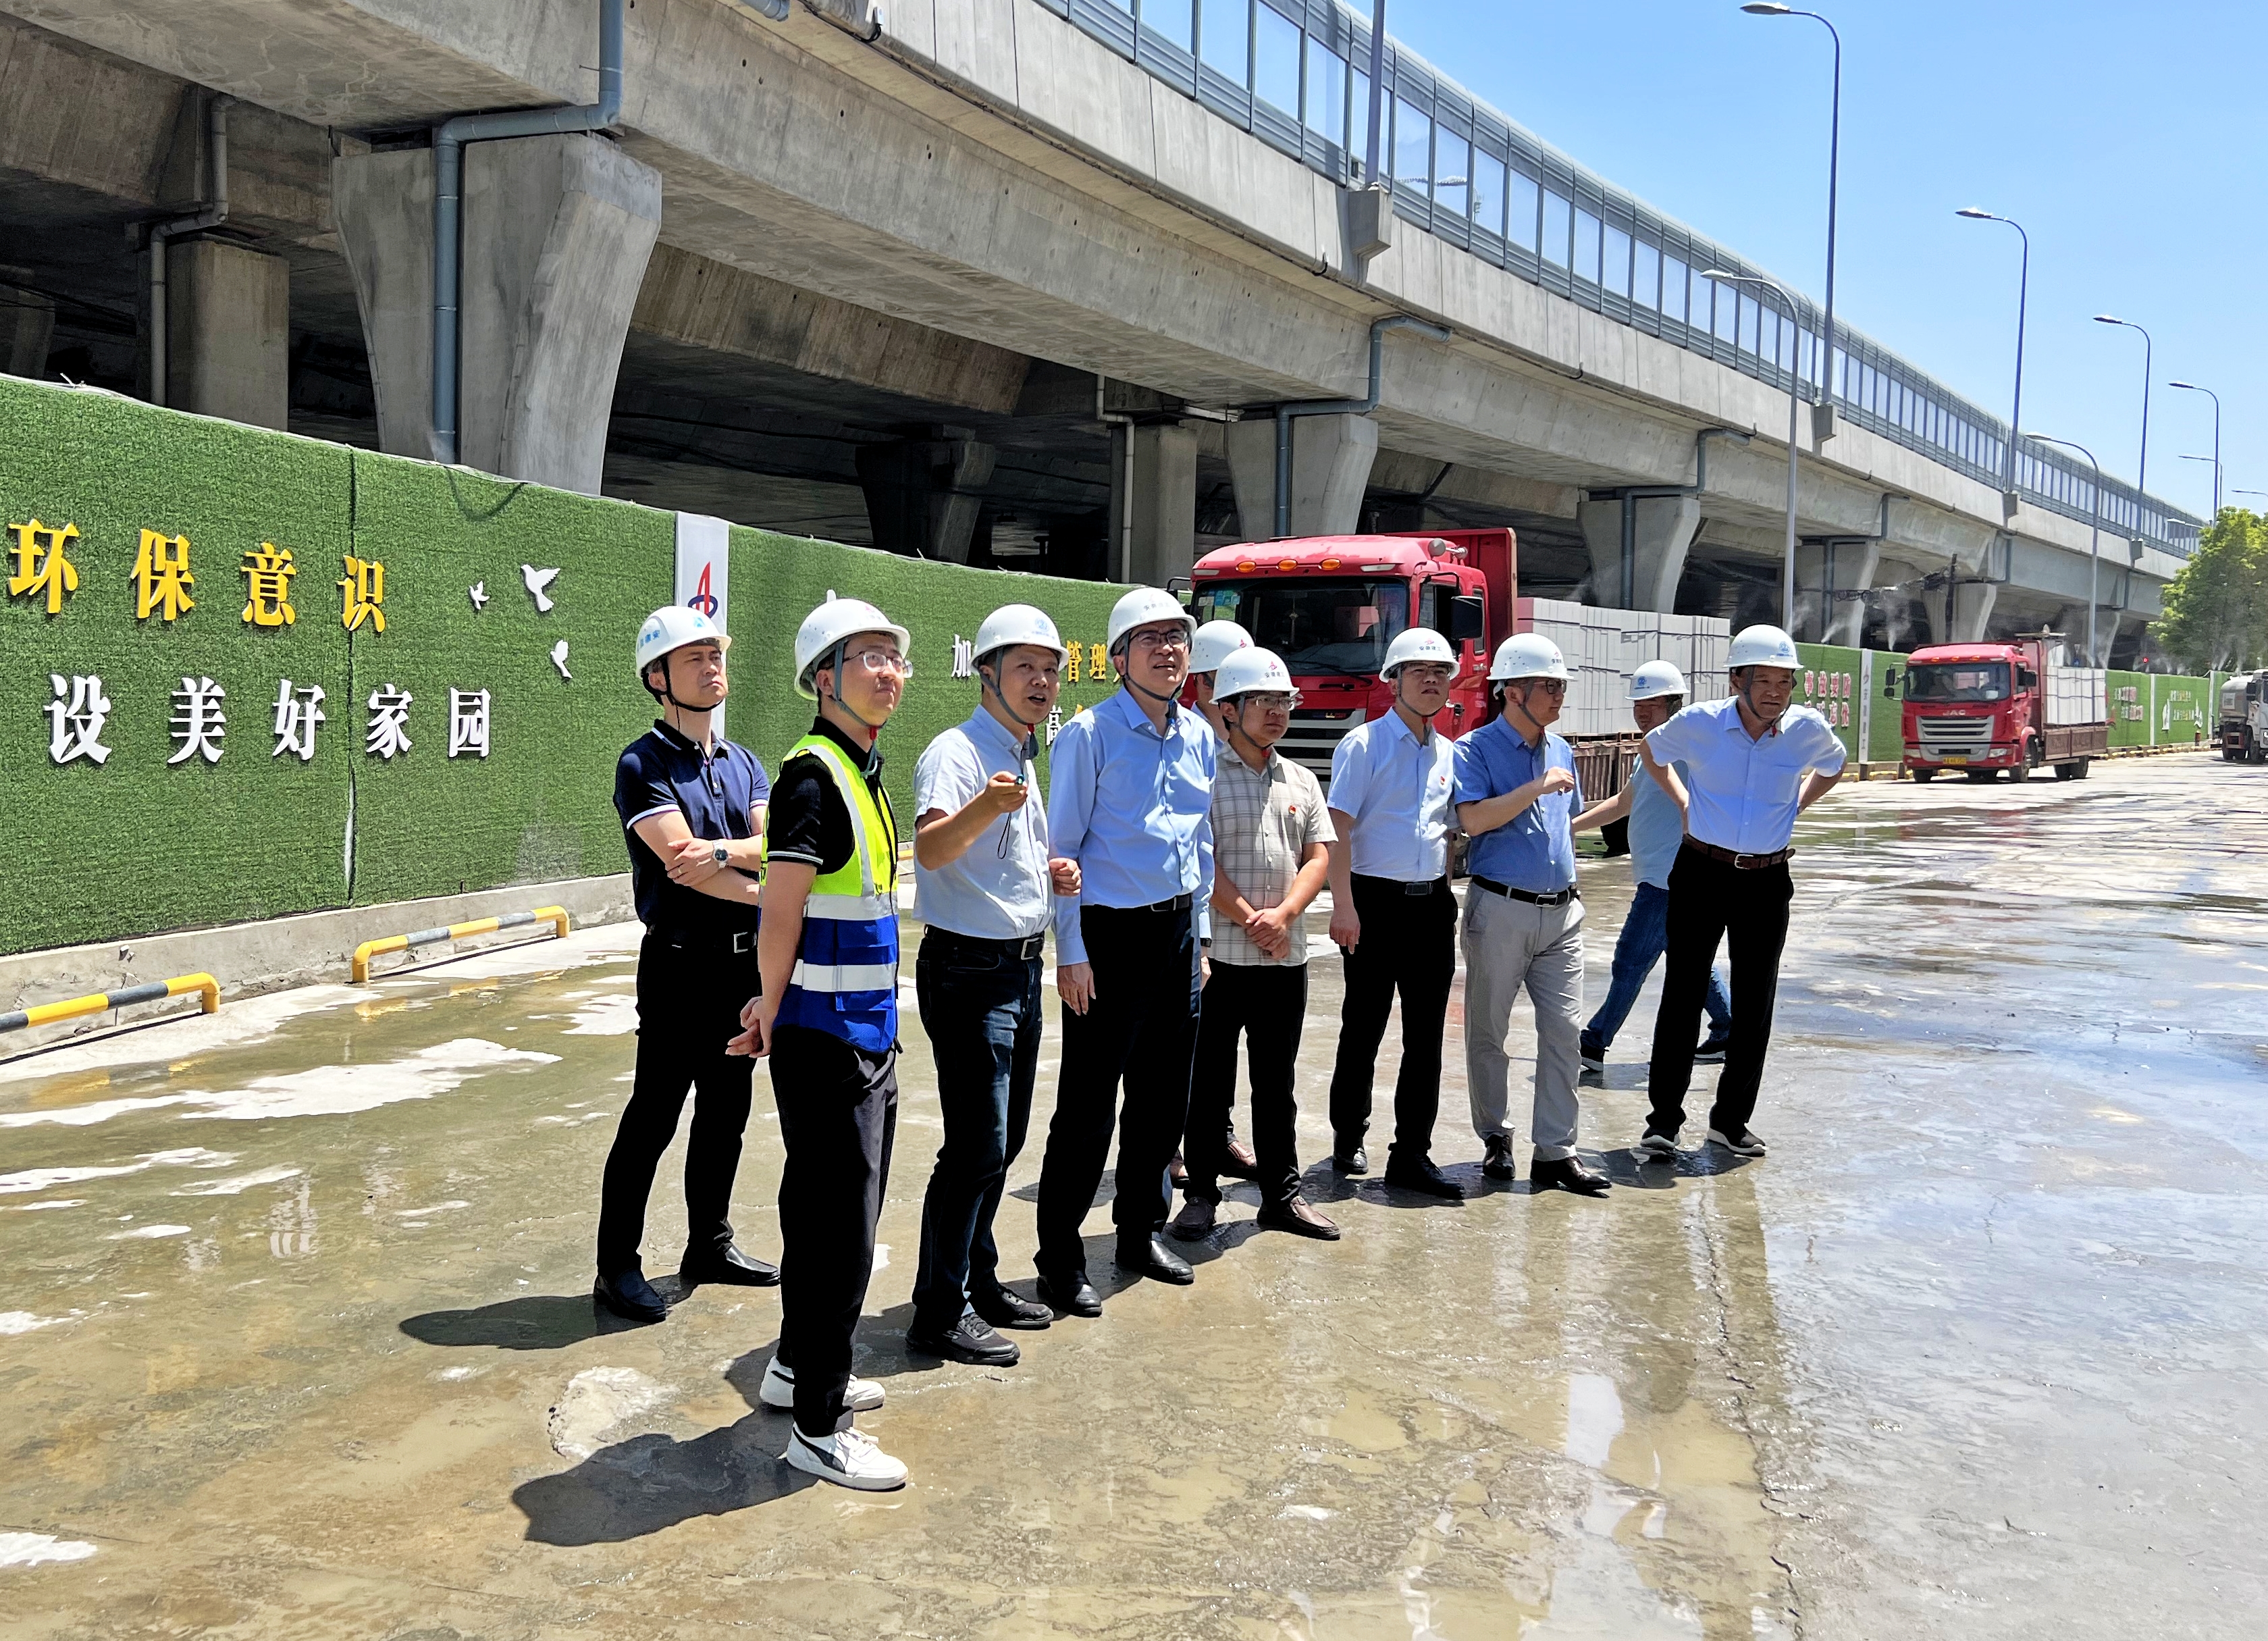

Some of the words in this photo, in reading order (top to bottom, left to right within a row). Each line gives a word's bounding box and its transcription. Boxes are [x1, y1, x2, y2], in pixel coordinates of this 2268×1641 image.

[8, 518, 386, 633] 环保意识
[951, 634, 977, 678] 加
[1066, 640, 1121, 683] 管理
[1804, 670, 1851, 698] 事故要防
[44, 673, 492, 764] 设美好家园
